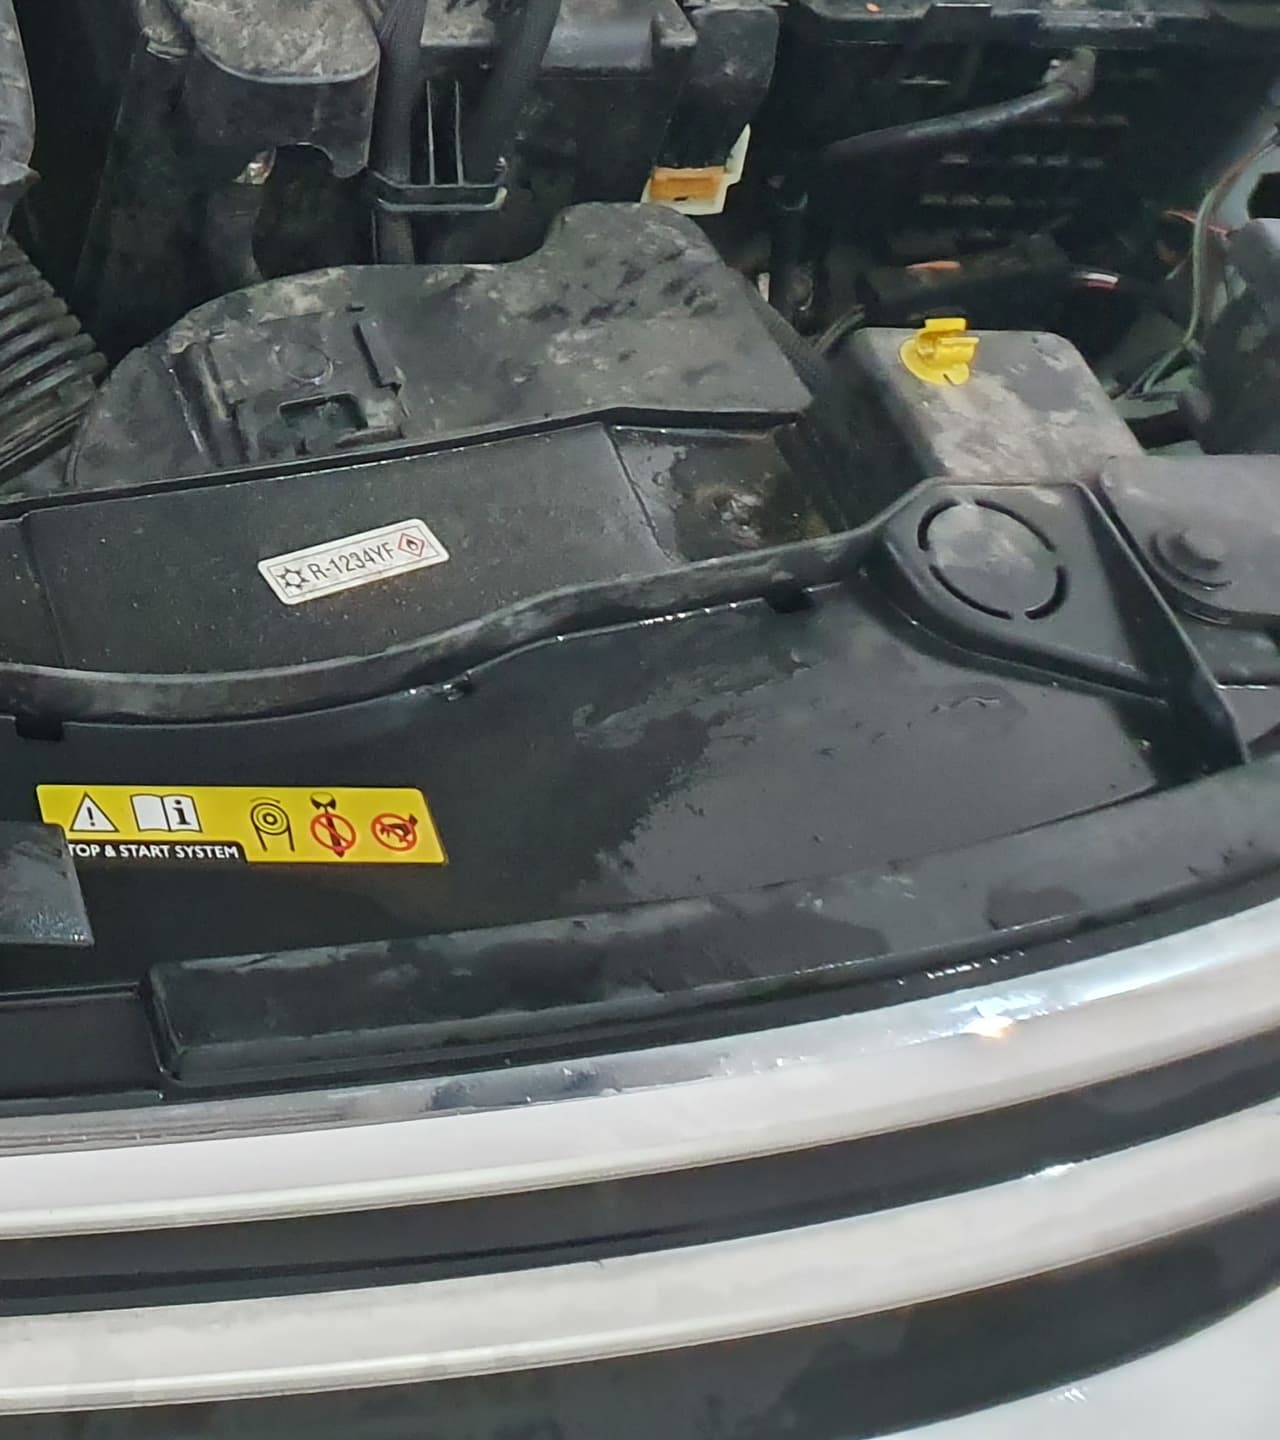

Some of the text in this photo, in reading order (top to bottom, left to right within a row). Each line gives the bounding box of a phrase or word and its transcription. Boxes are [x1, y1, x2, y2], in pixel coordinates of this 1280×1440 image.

[307, 541, 396, 582] R-1234YF
[67, 843, 240, 860] TOP & START SYSTEM
